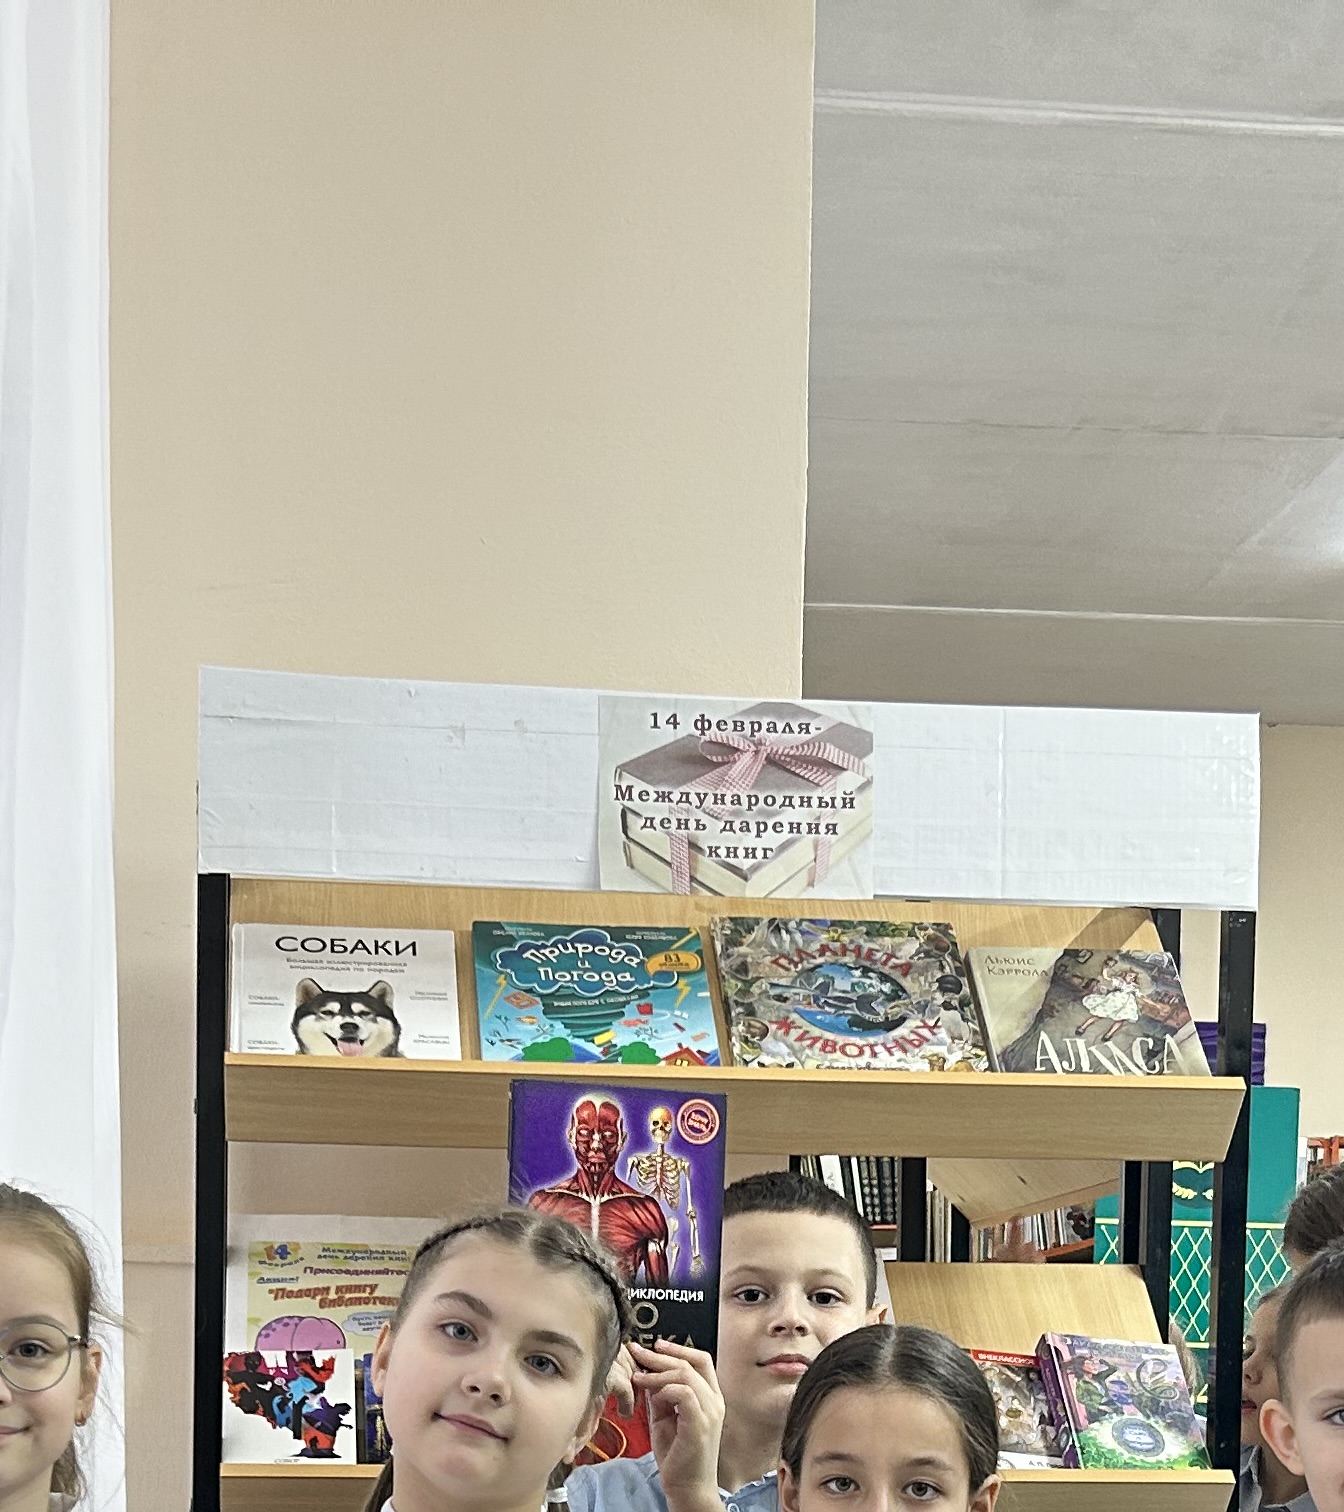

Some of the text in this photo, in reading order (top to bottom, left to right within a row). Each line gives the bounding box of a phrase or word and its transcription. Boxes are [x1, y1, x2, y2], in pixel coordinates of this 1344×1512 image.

[649, 712, 823, 736] 14 февраля-
[613, 784, 857, 811] Международный
[640, 815, 839, 839] день дарения
[706, 845, 774, 860] книг
[274, 935, 418, 957] СОБАКИ
[522, 941, 642, 969] Природа
[769, 942, 914, 977] ПЛАНЕТА
[537, 966, 636, 988] Погода
[768, 1014, 943, 1059] ЖИВОТНЫХ
[1034, 1030, 1191, 1077] АЛИСА
[628, 1287, 705, 1304] ИКЛОПЕДИЯ
